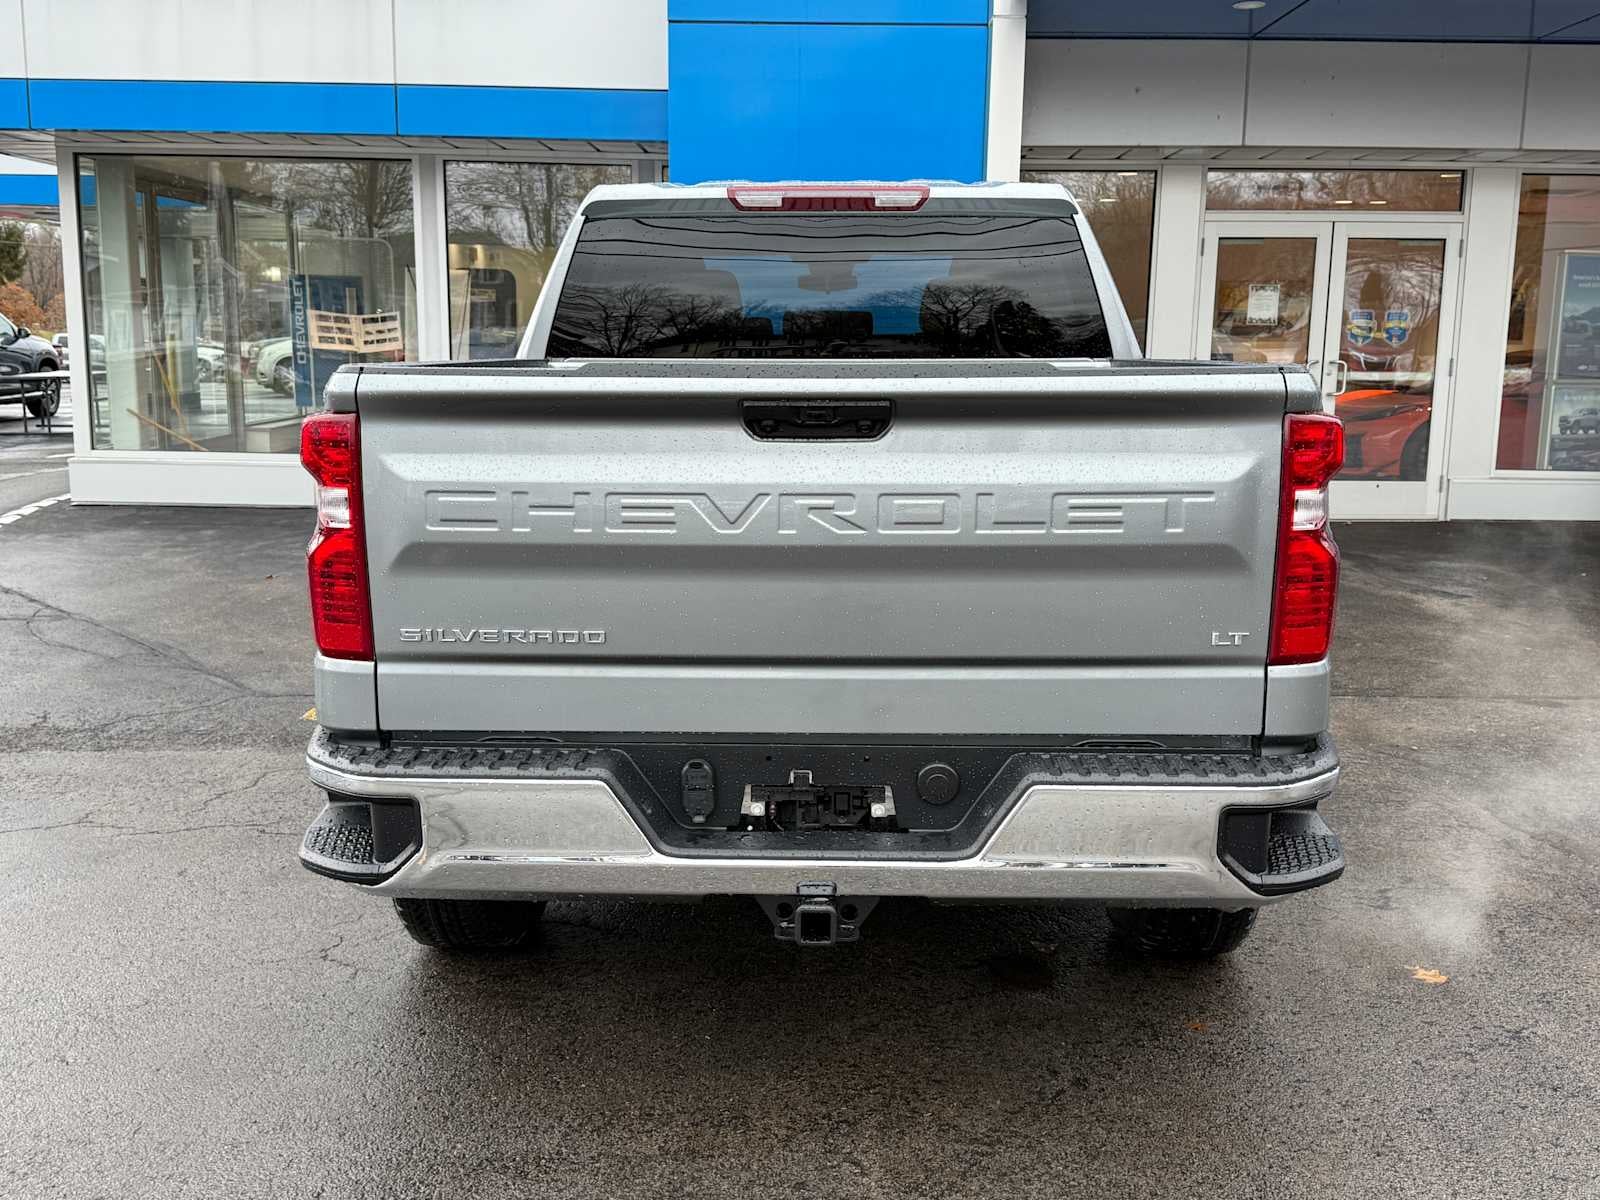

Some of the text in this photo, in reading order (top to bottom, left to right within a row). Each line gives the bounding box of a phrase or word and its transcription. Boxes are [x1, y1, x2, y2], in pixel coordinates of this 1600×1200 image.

[293, 279, 307, 364] CHEVROLET
[424, 490, 1216, 535] CHEVROLET
[399, 627, 607, 645] SILVERADO
[1211, 631, 1250, 646] LT
